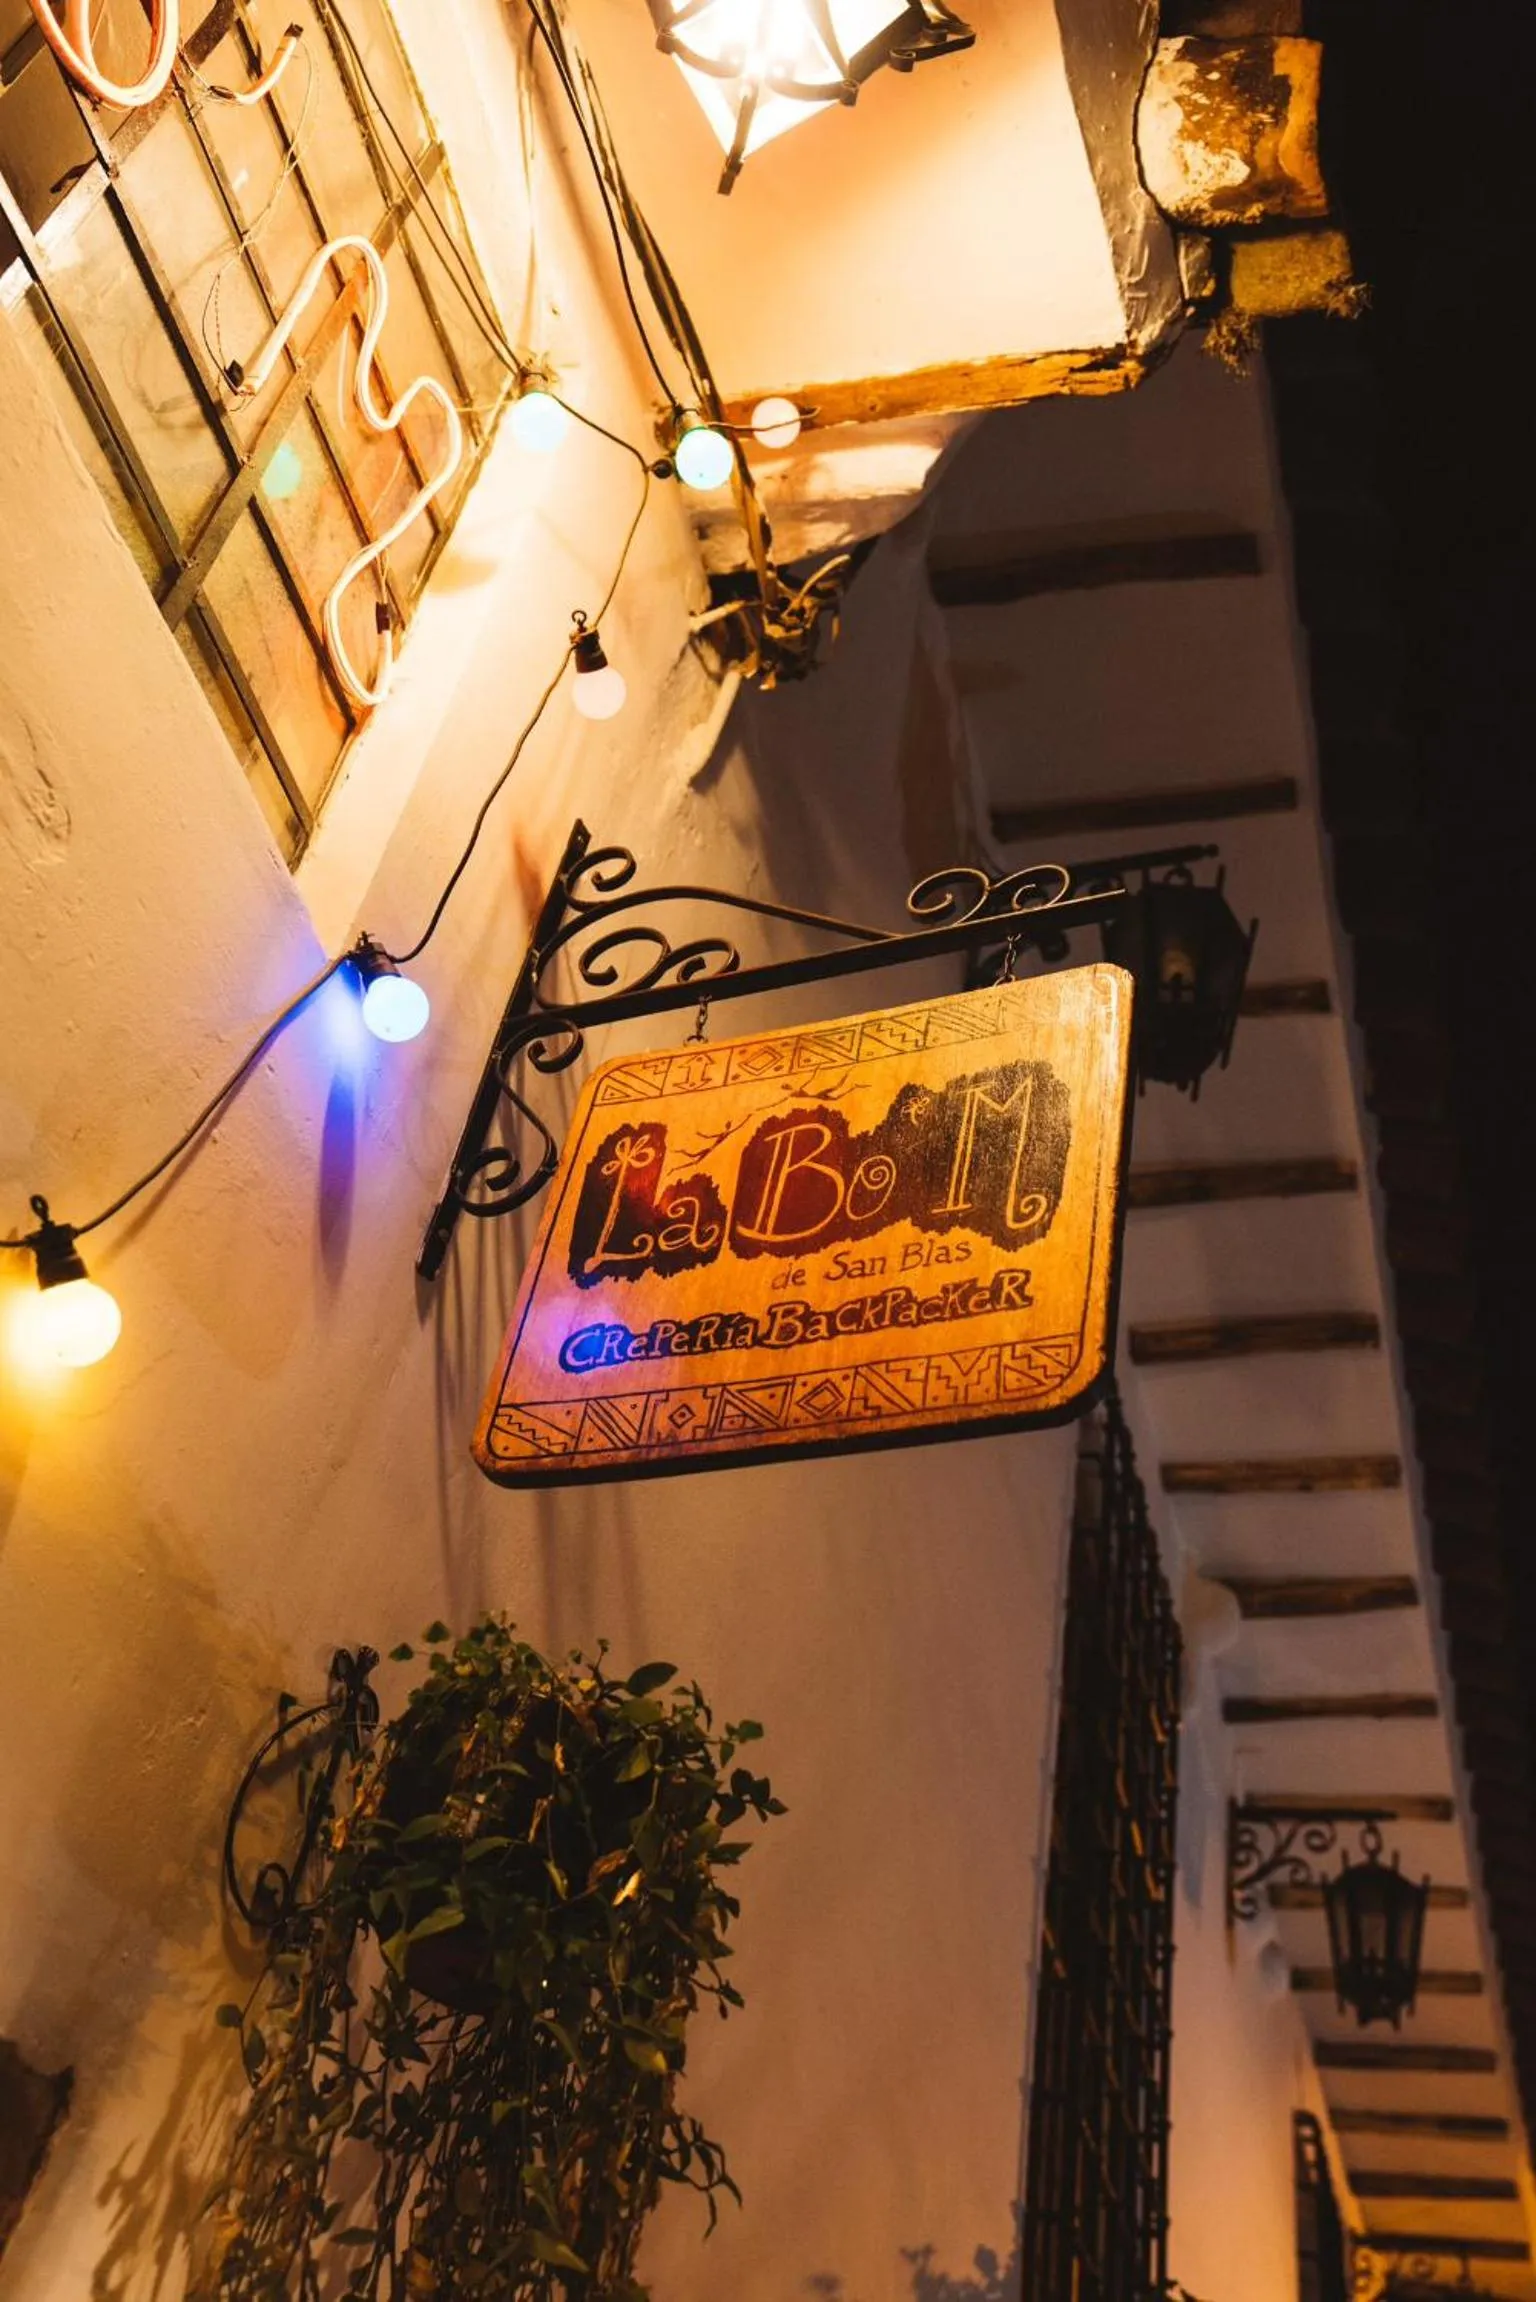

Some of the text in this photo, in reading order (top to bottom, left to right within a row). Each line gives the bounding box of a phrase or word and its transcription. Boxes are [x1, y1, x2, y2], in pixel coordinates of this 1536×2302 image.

[584, 1133, 721, 1274] La
[771, 1238, 974, 1291] de San Blas
